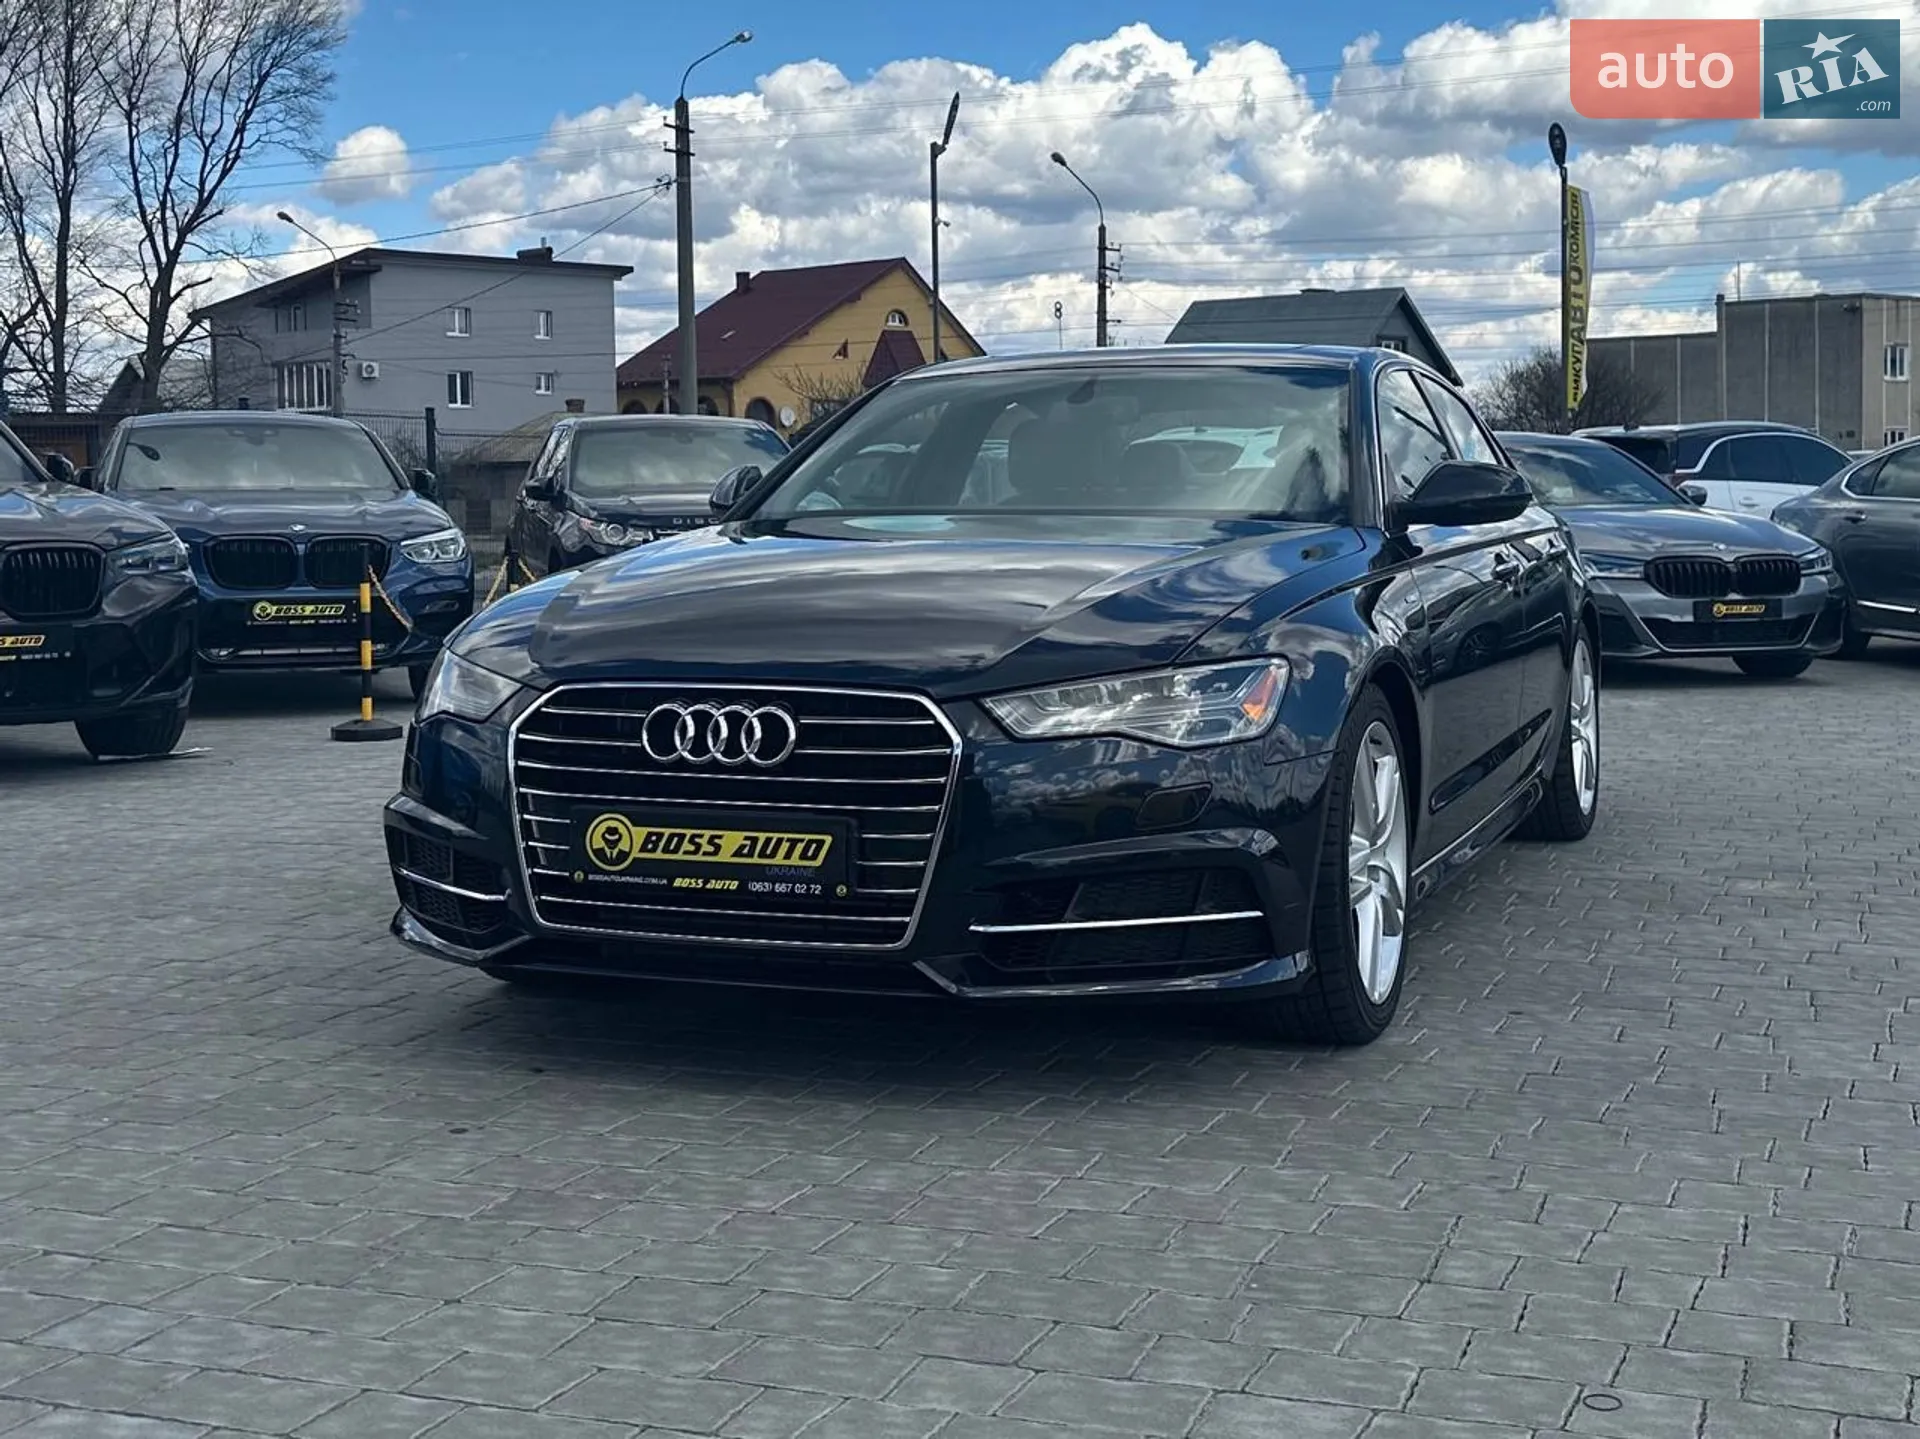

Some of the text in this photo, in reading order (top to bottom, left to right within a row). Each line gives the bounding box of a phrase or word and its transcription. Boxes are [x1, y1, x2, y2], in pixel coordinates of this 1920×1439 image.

[274, 605, 343, 615] BOSS AUTO
[10, 636, 43, 646] AUTO
[637, 831, 827, 861] BOSS AUTO
[765, 866, 816, 878] UKRAINE
[672, 877, 740, 891] BOSS AUTO
[748, 881, 772, 892] (063)
[794, 883, 808, 894] 02
[809, 884, 823, 895] 72
